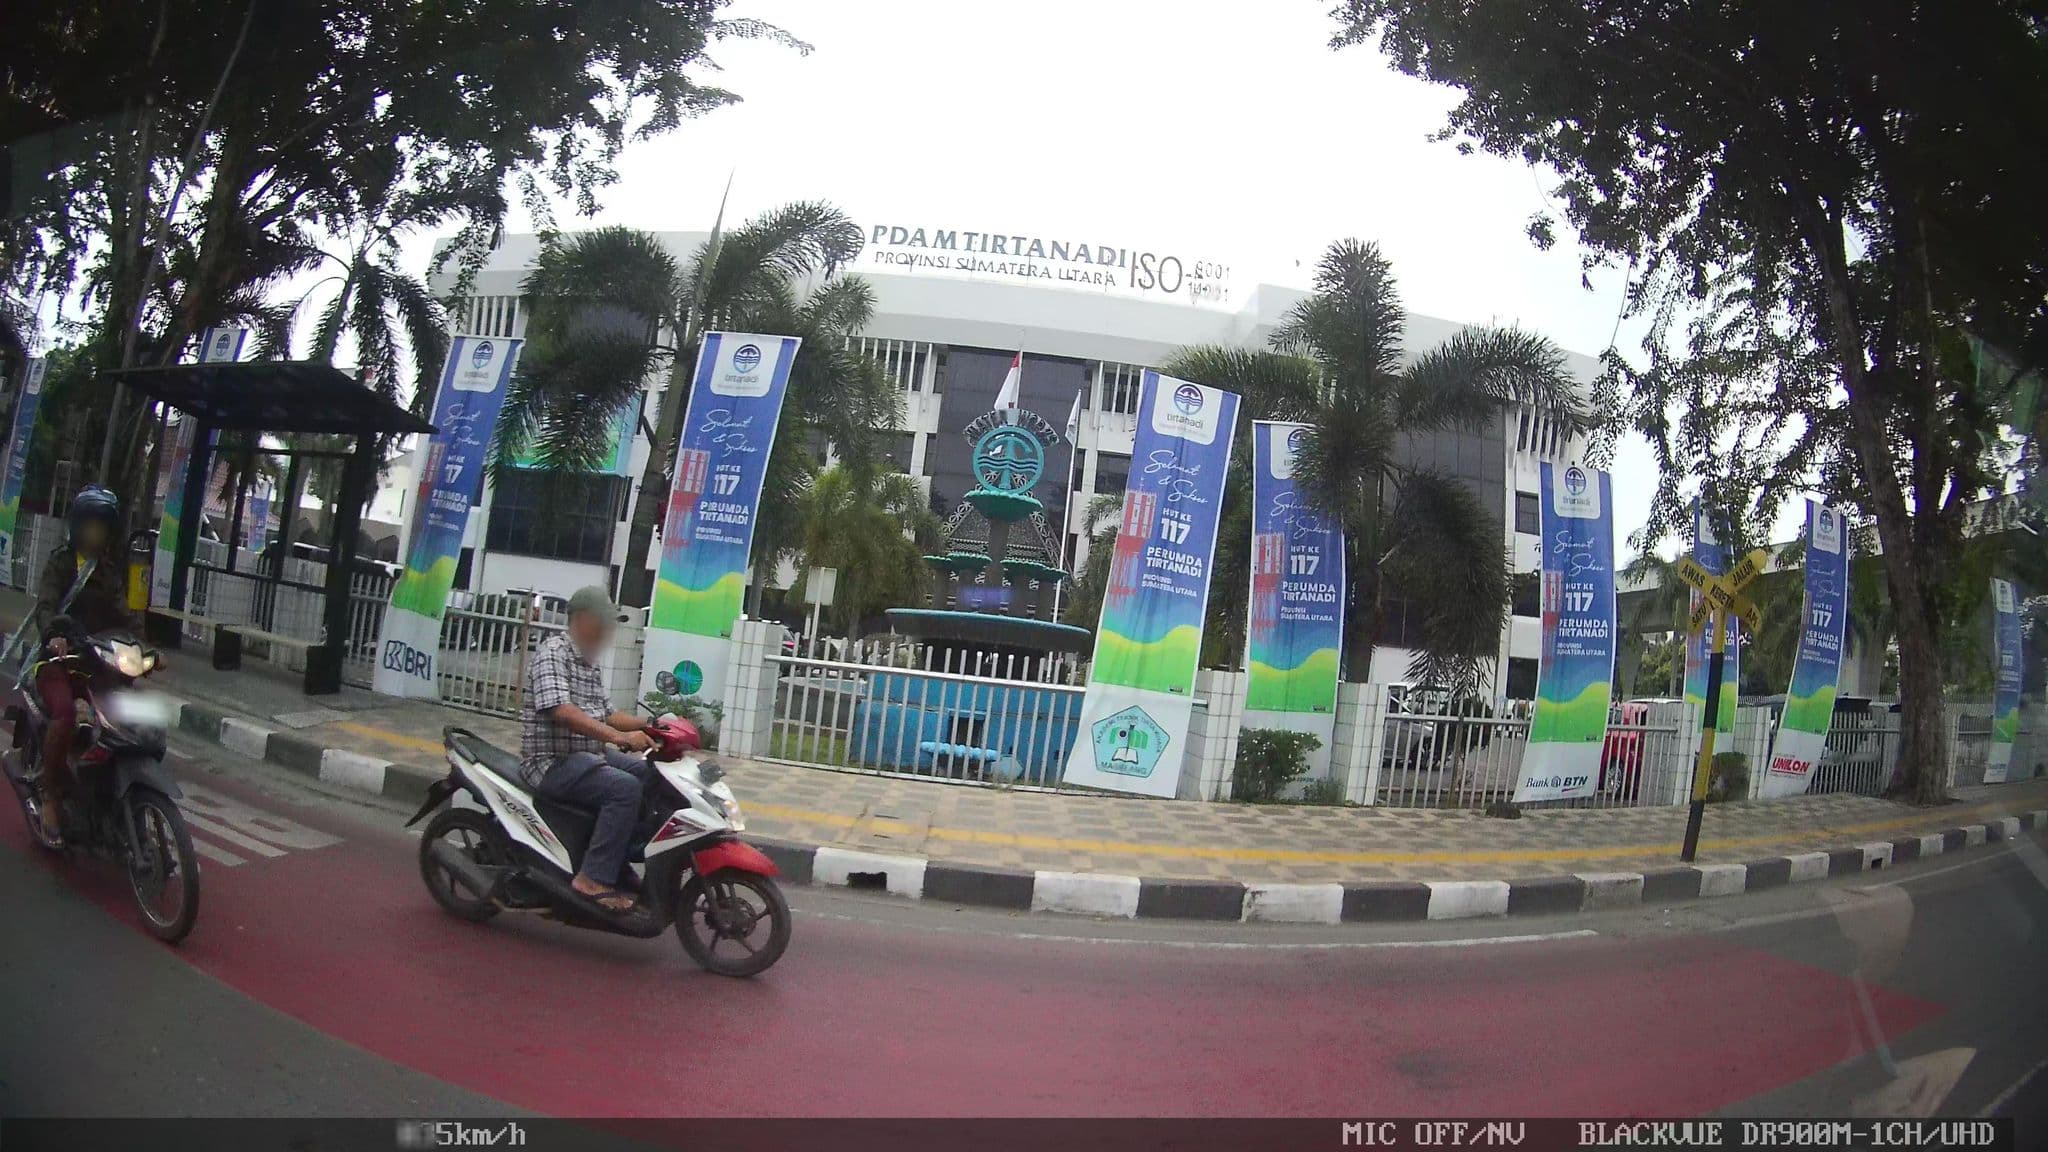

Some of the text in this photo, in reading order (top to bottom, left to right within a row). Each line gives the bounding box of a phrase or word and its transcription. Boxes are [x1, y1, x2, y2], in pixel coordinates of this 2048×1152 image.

[871, 225, 1127, 269] PDAM TIRTANADI
[874, 251, 1117, 287] PROVINSI SUMATERA UTARA
[1162, 507, 1193, 523] HUT KE
[1161, 518, 1192, 545] 117
[1146, 545, 1203, 568] PERUMDA
[1306, 545, 1320, 554] KE
[1145, 556, 1203, 578] TIRTANADI
[1290, 554, 1321, 576] 117
[1681, 563, 1706, 588] AWAS
[1732, 558, 1756, 587] JALUR
[1281, 590, 1336, 604] TIRTANADI
[1282, 580, 1336, 593] PERUMDA
[1582, 583, 1594, 592] KE
[1565, 592, 1595, 613] 117
[1811, 609, 1833, 628] 117
[404, 646, 432, 681] BRI
[1772, 757, 1810, 773] UNILON
[1525, 775, 1588, 788] Bank BTN
